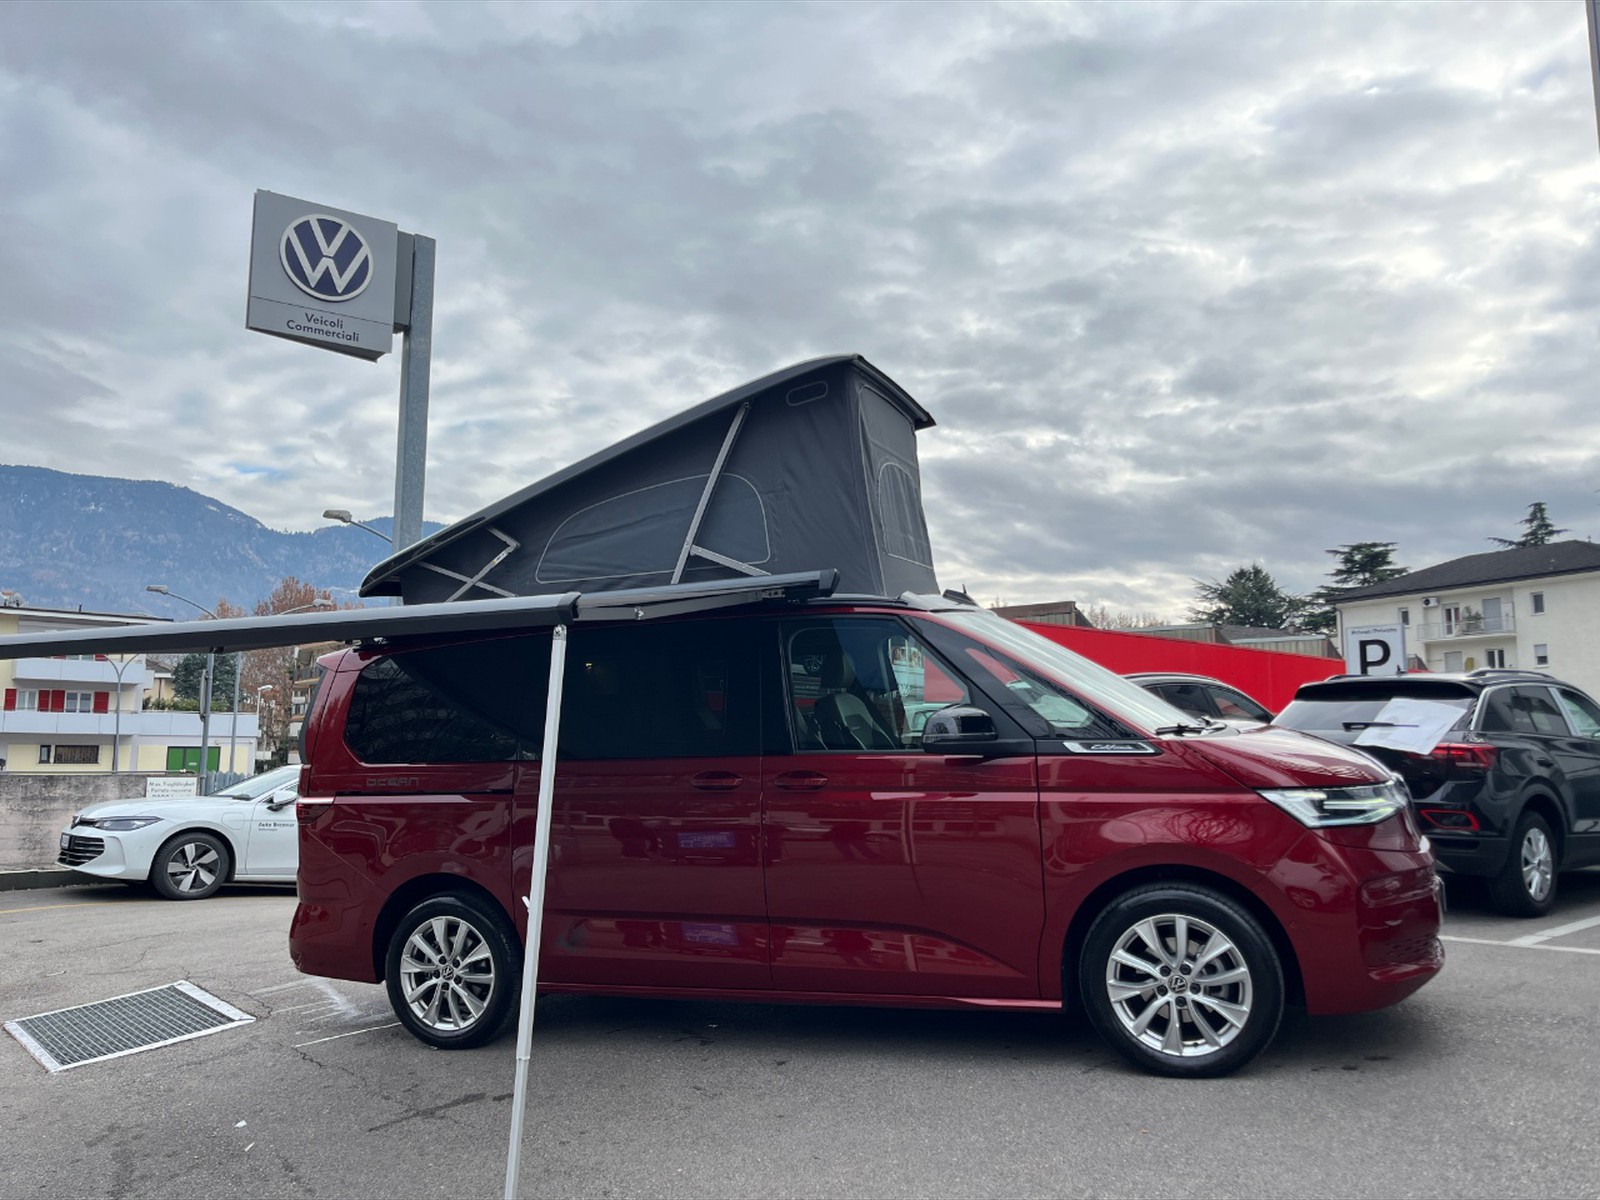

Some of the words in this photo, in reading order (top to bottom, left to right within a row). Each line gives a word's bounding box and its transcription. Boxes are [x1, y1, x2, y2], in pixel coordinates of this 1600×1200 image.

[286, 319, 360, 342] Commerciali
[305, 312, 344, 329] Veicoli
[1359, 639, 1391, 676] P
